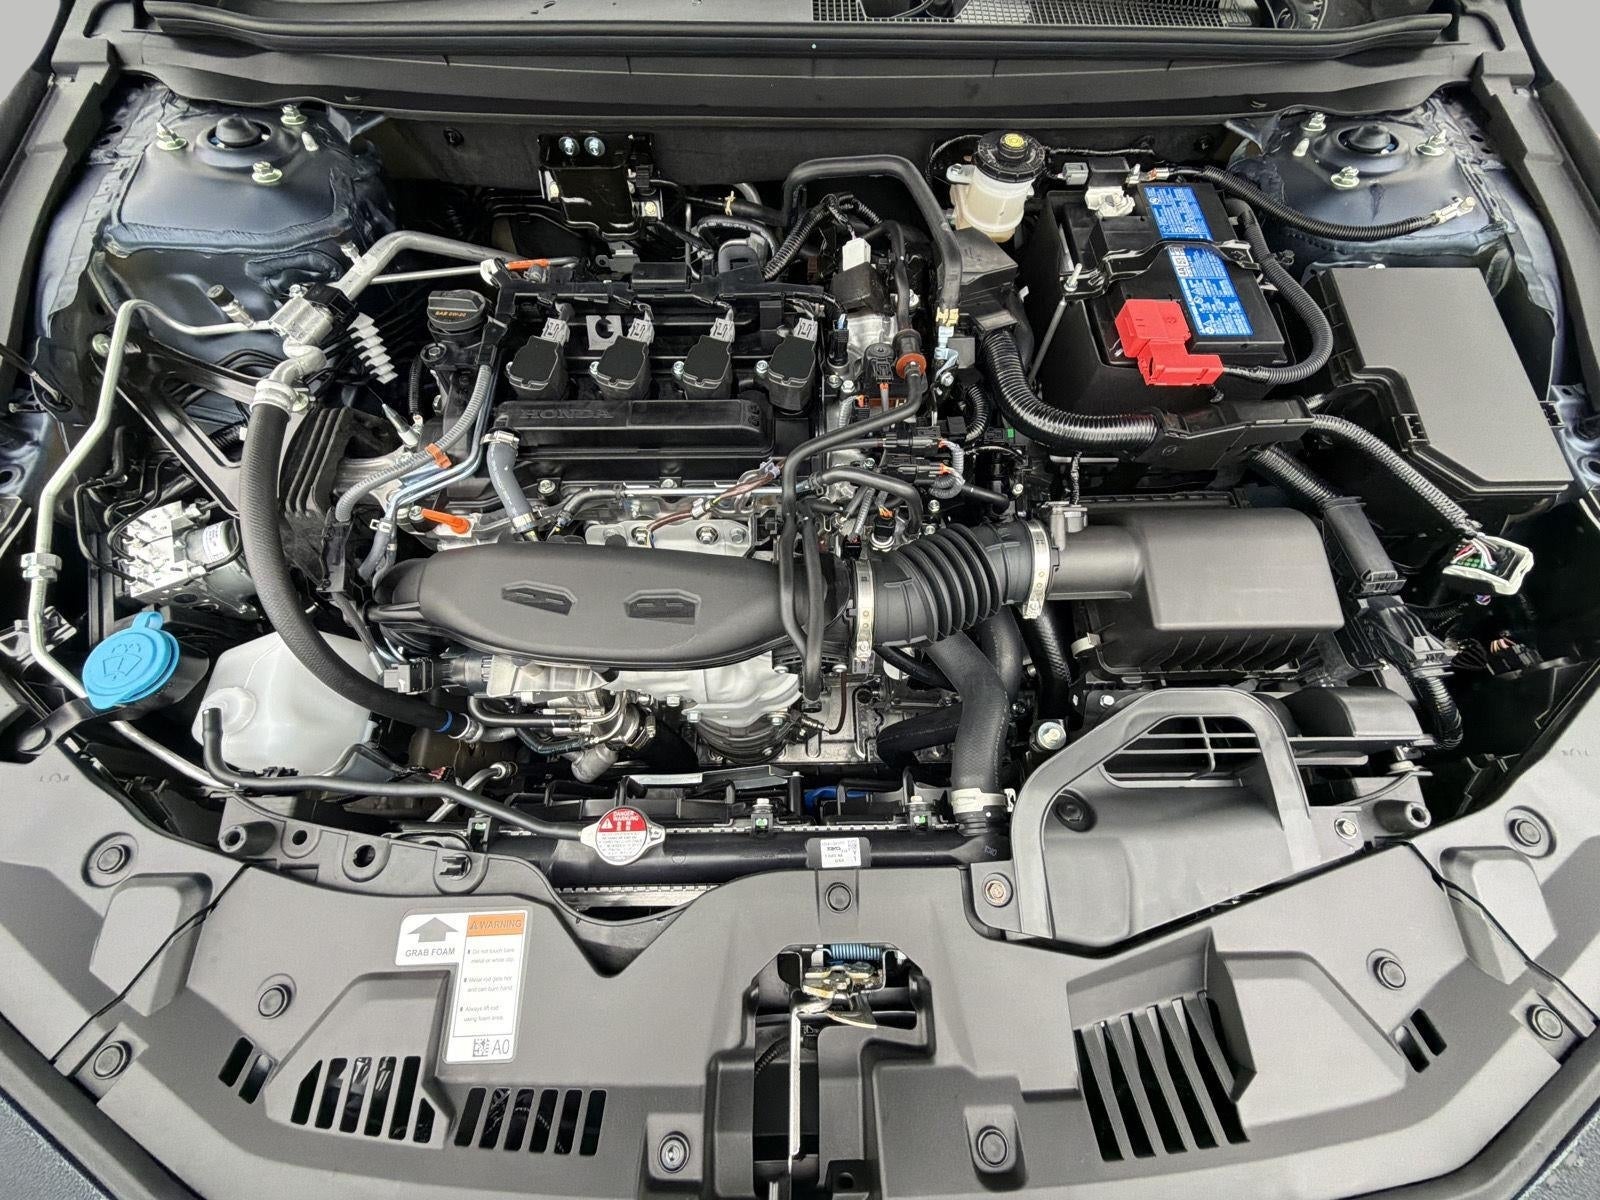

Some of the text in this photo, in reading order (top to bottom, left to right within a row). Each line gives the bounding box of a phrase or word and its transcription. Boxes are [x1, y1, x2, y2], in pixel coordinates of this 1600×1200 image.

[519, 408, 614, 419] HONDA
[480, 919, 522, 930] WARNING
[405, 947, 455, 957] GRAB FOAM
[491, 1038, 510, 1055] A0
